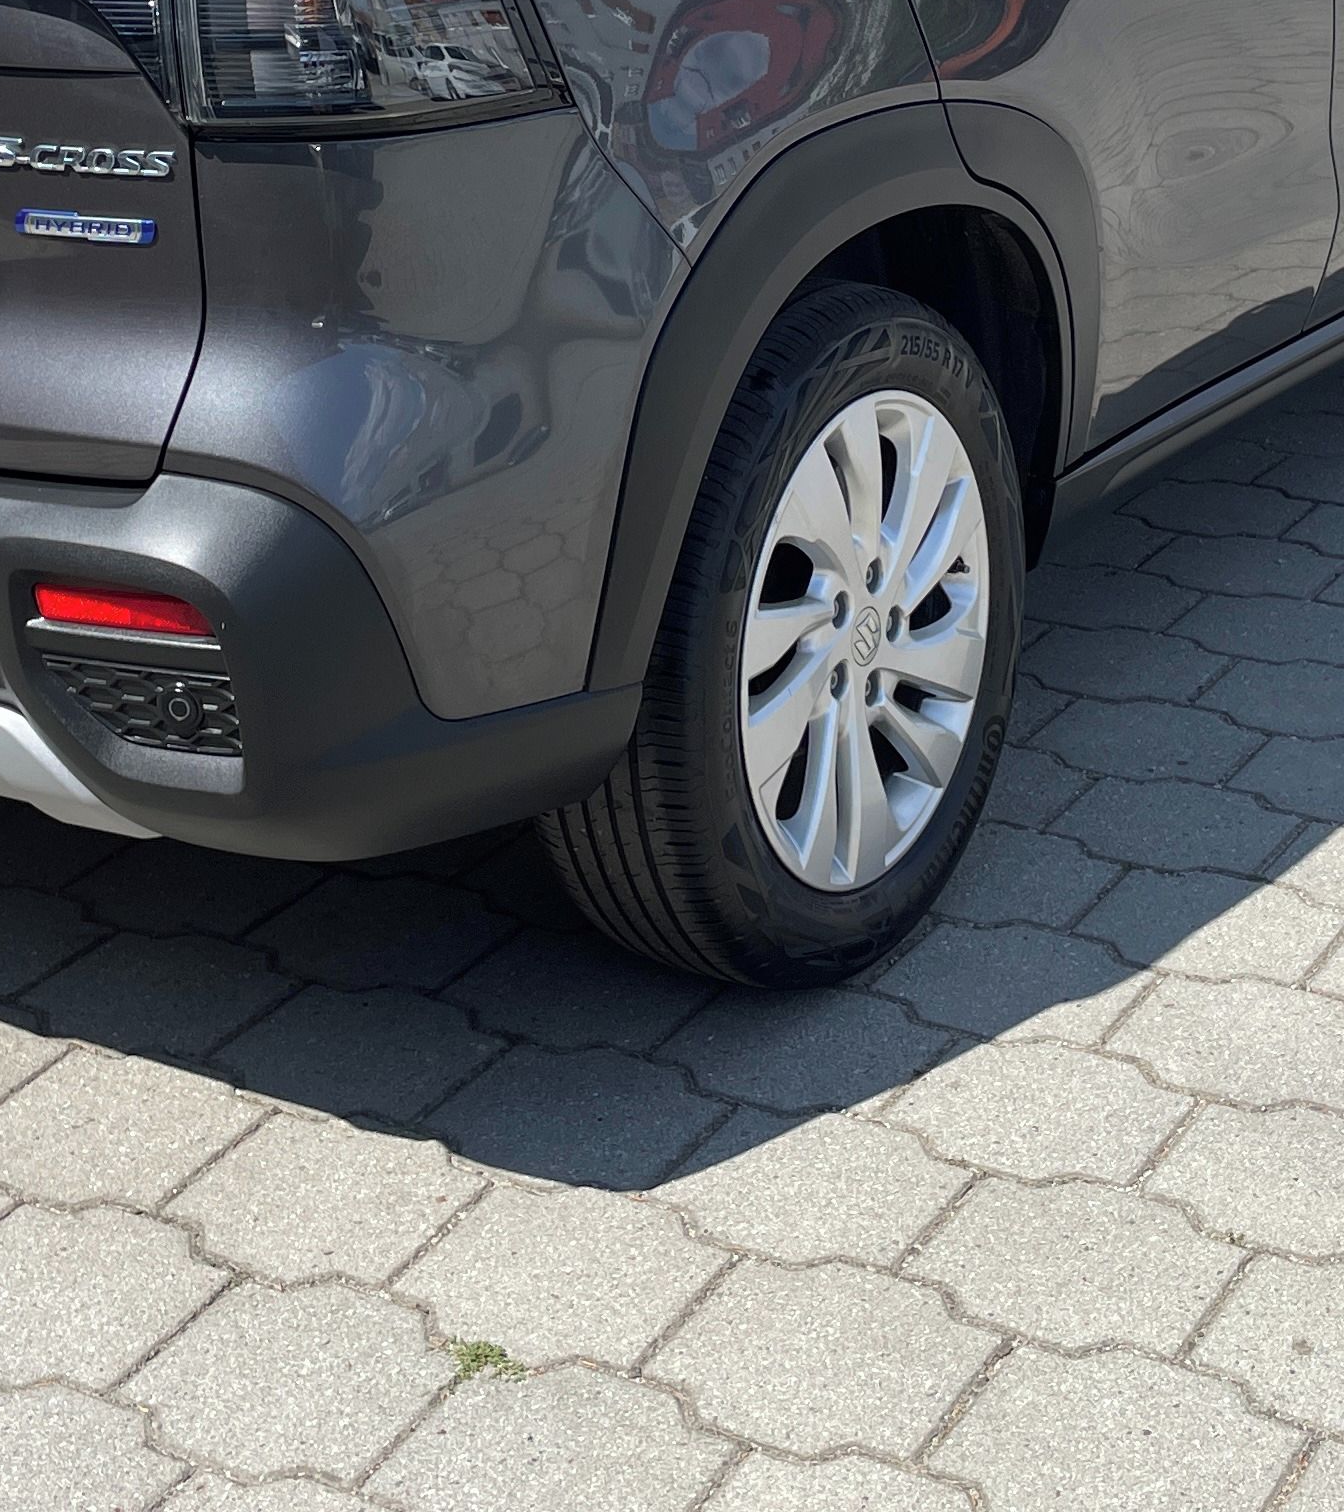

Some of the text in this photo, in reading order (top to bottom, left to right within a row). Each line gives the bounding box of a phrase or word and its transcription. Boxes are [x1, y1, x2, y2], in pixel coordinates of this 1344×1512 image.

[34, 218, 133, 237] HYBRID
[900, 334, 941, 362] 215/55
[941, 347, 952, 370] R
[951, 354, 964, 379] 17
